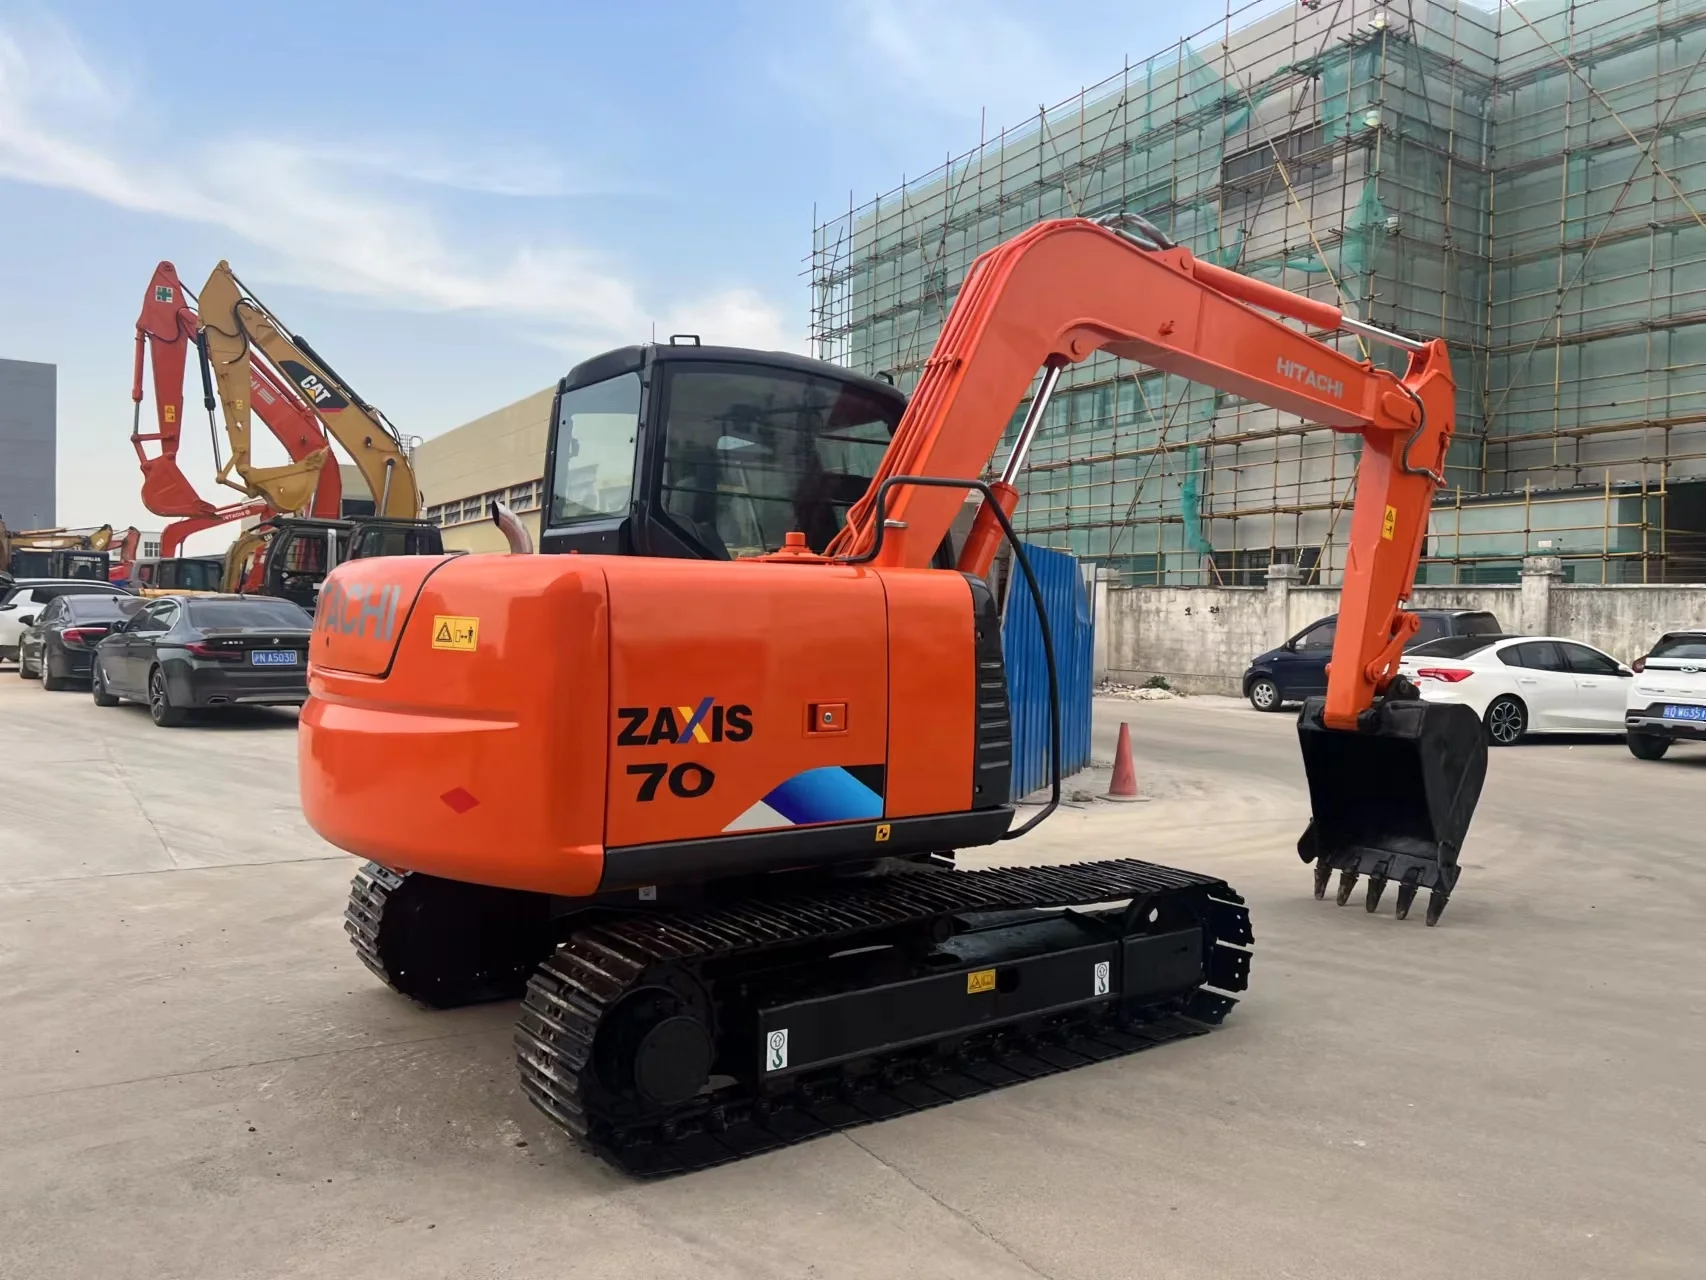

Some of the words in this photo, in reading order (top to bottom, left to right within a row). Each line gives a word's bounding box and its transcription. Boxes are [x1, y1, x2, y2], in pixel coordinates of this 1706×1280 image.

[300, 374, 331, 403] CAT
[1276, 355, 1344, 400] HITACHI
[313, 583, 401, 641] TACHI
[617, 697, 753, 746] ZAXIS
[626, 762, 715, 802] 70
